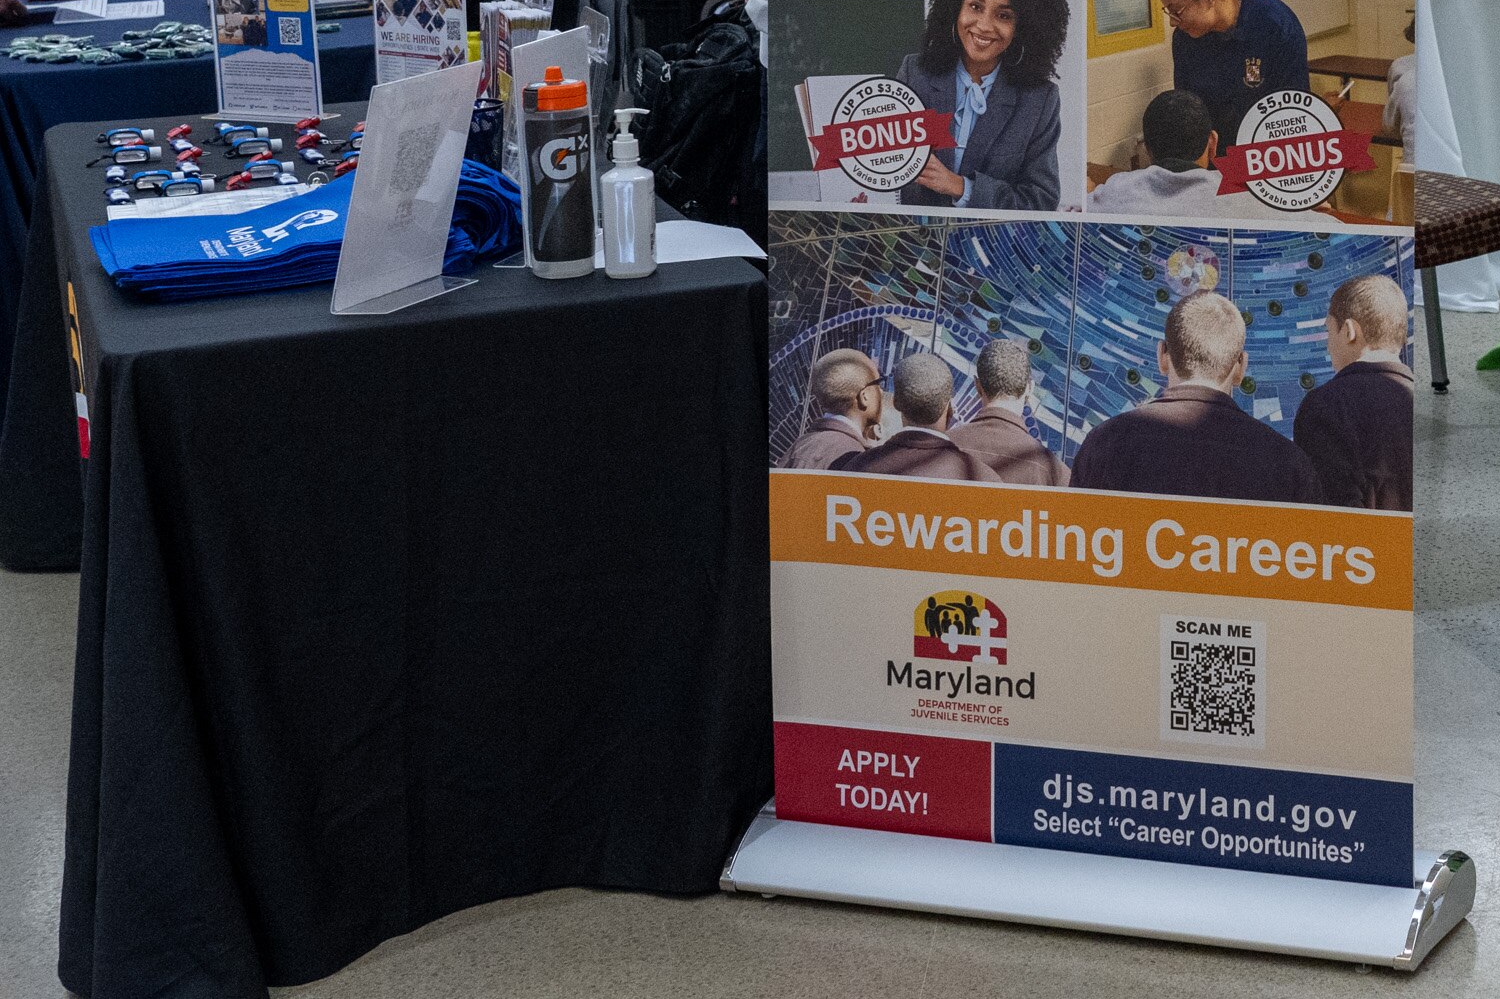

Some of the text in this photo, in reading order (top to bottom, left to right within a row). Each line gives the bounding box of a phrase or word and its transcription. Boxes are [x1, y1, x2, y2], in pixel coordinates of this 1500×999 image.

[381, 31, 394, 41] WE
[412, 34, 441, 46] HIRING
[841, 83, 916, 117] UP TO $3,500
[861, 103, 897, 116] TEACHER
[1256, 92, 1313, 115] $5,000
[840, 117, 927, 153] BONUS
[1265, 115, 1307, 131] RESIDENT
[1268, 124, 1308, 139] ADVISOR
[870, 153, 905, 167] TEACHER
[1245, 137, 1343, 176] BONUS
[852, 157, 922, 187] Varies By Position
[1278, 173, 1316, 188] TRAINEE
[1255, 169, 1336, 207] Payable Over 3 Years
[825, 494, 1377, 586] Rewarding Careers
[1175, 620, 1252, 638] SCAN ME
[886, 660, 1035, 700] Maryland
[911, 709, 1009, 726] JUVENILE SERVICES
[918, 699, 1003, 714] DEPARTMENT OF
[837, 749, 920, 778] APPLY
[835, 783, 928, 815] TODAY!
[1043, 773, 1357, 833] djs.maryland.gov
[1033, 809, 1102, 837] Select
[1108, 817, 1195, 846] “Career
